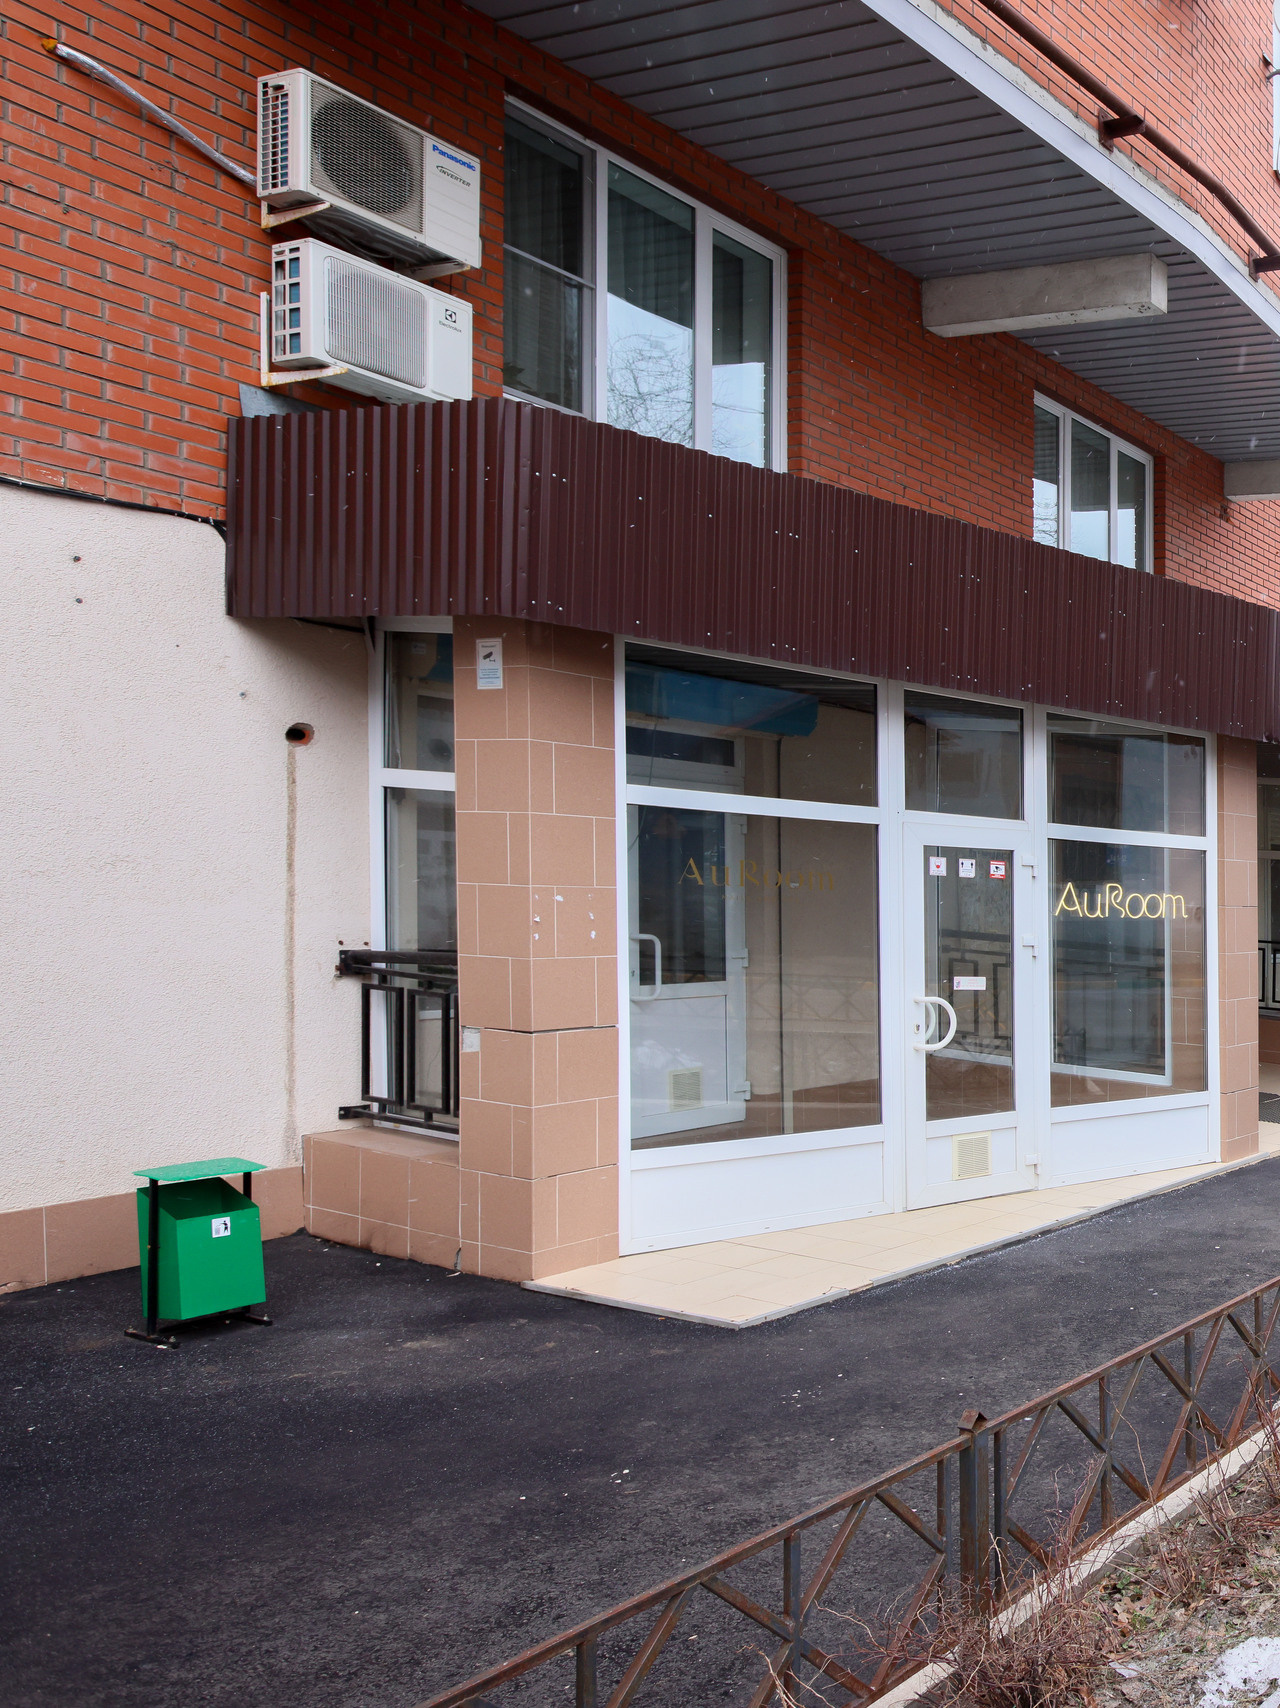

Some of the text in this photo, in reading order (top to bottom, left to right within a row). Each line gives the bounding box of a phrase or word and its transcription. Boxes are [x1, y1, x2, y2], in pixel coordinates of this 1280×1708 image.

[432, 144, 476, 172] Panasonic
[439, 168, 471, 187] INVERTER
[438, 320, 462, 333] Electrolux
[678, 857, 834, 891] AuRoom
[1054, 882, 1188, 919] AuRoom
